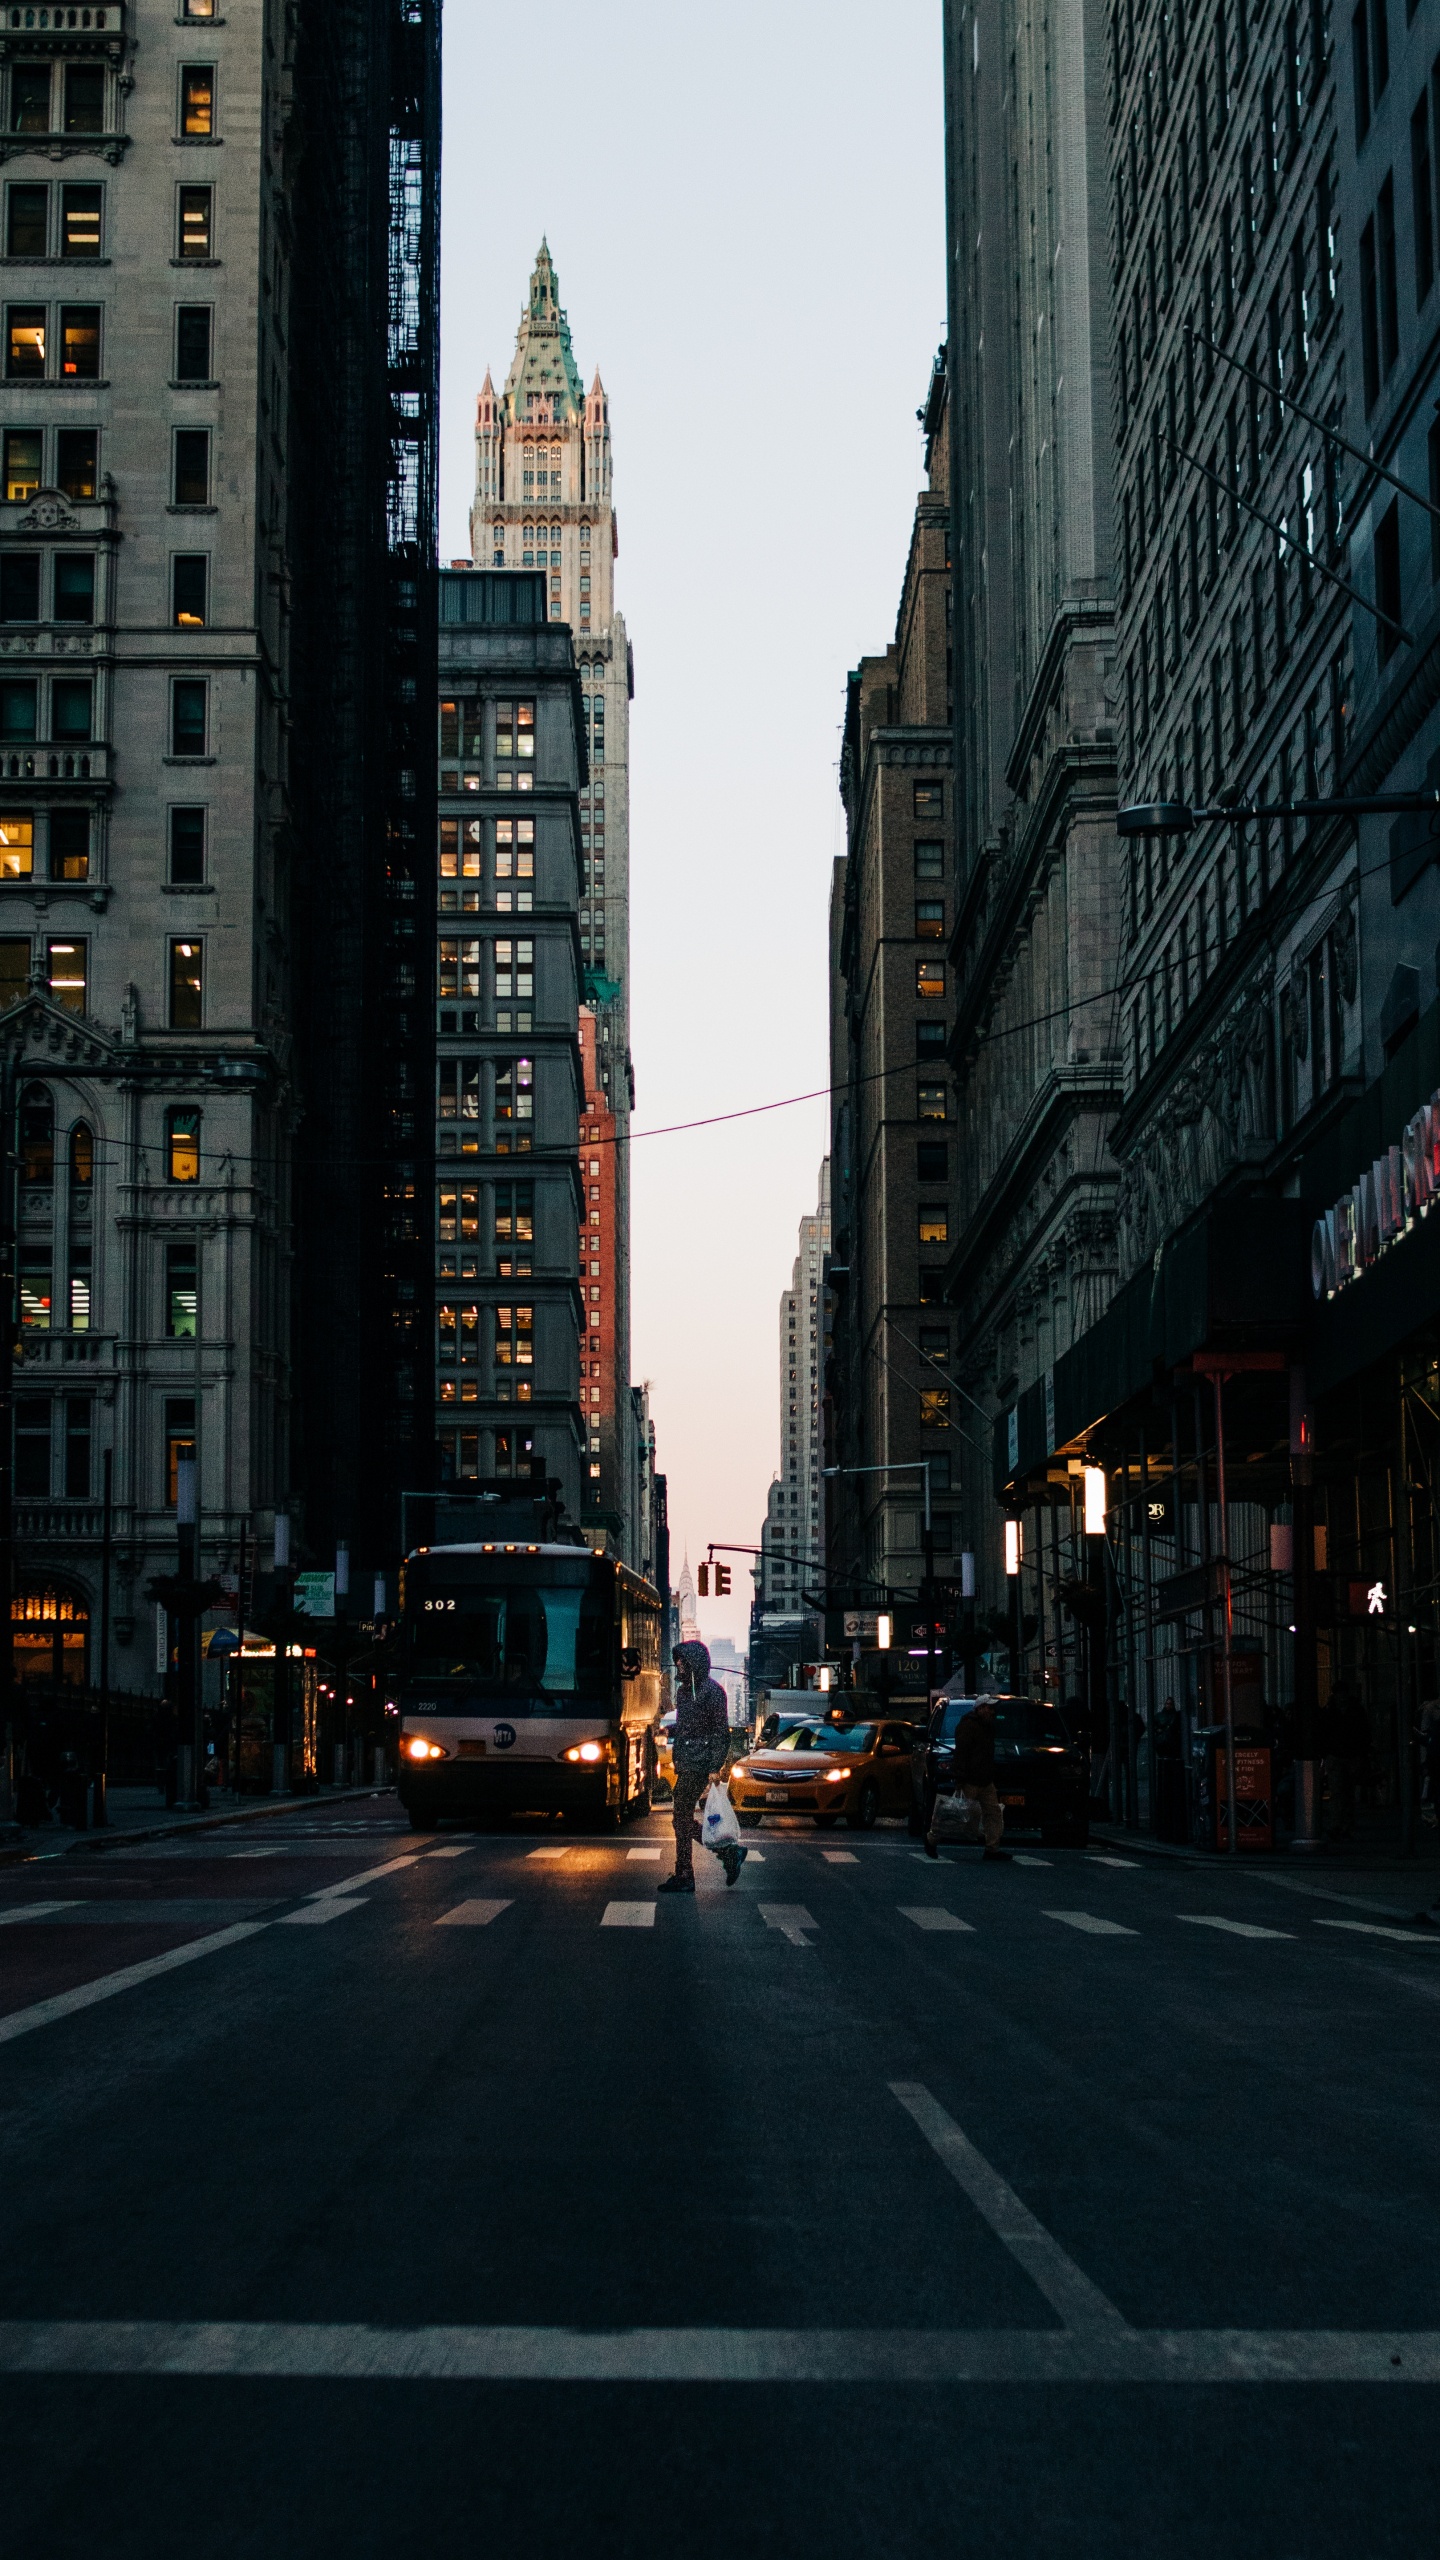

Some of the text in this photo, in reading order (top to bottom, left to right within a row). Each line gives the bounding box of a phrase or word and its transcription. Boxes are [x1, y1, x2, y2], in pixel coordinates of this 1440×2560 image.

[424, 1599, 456, 1611] 302
[898, 1659, 920, 1671] 120
[418, 1702, 437, 1711] 2220
[494, 1728, 513, 1744] MTA
